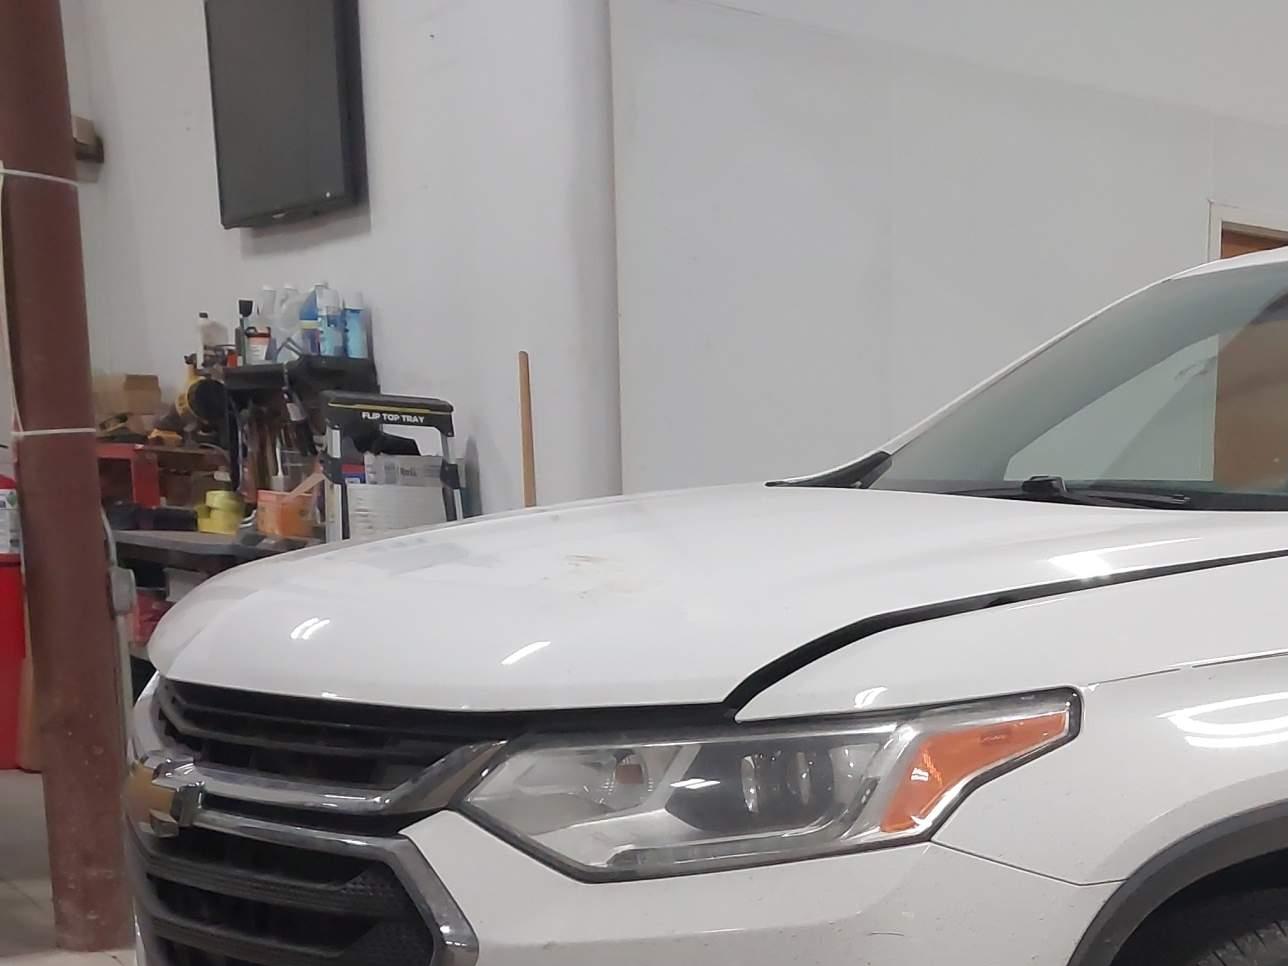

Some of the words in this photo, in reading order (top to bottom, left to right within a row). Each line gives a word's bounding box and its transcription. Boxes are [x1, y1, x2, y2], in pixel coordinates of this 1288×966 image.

[361, 411, 380, 420] FLIP
[382, 413, 400, 422] TOP
[401, 414, 425, 423] TRAY
